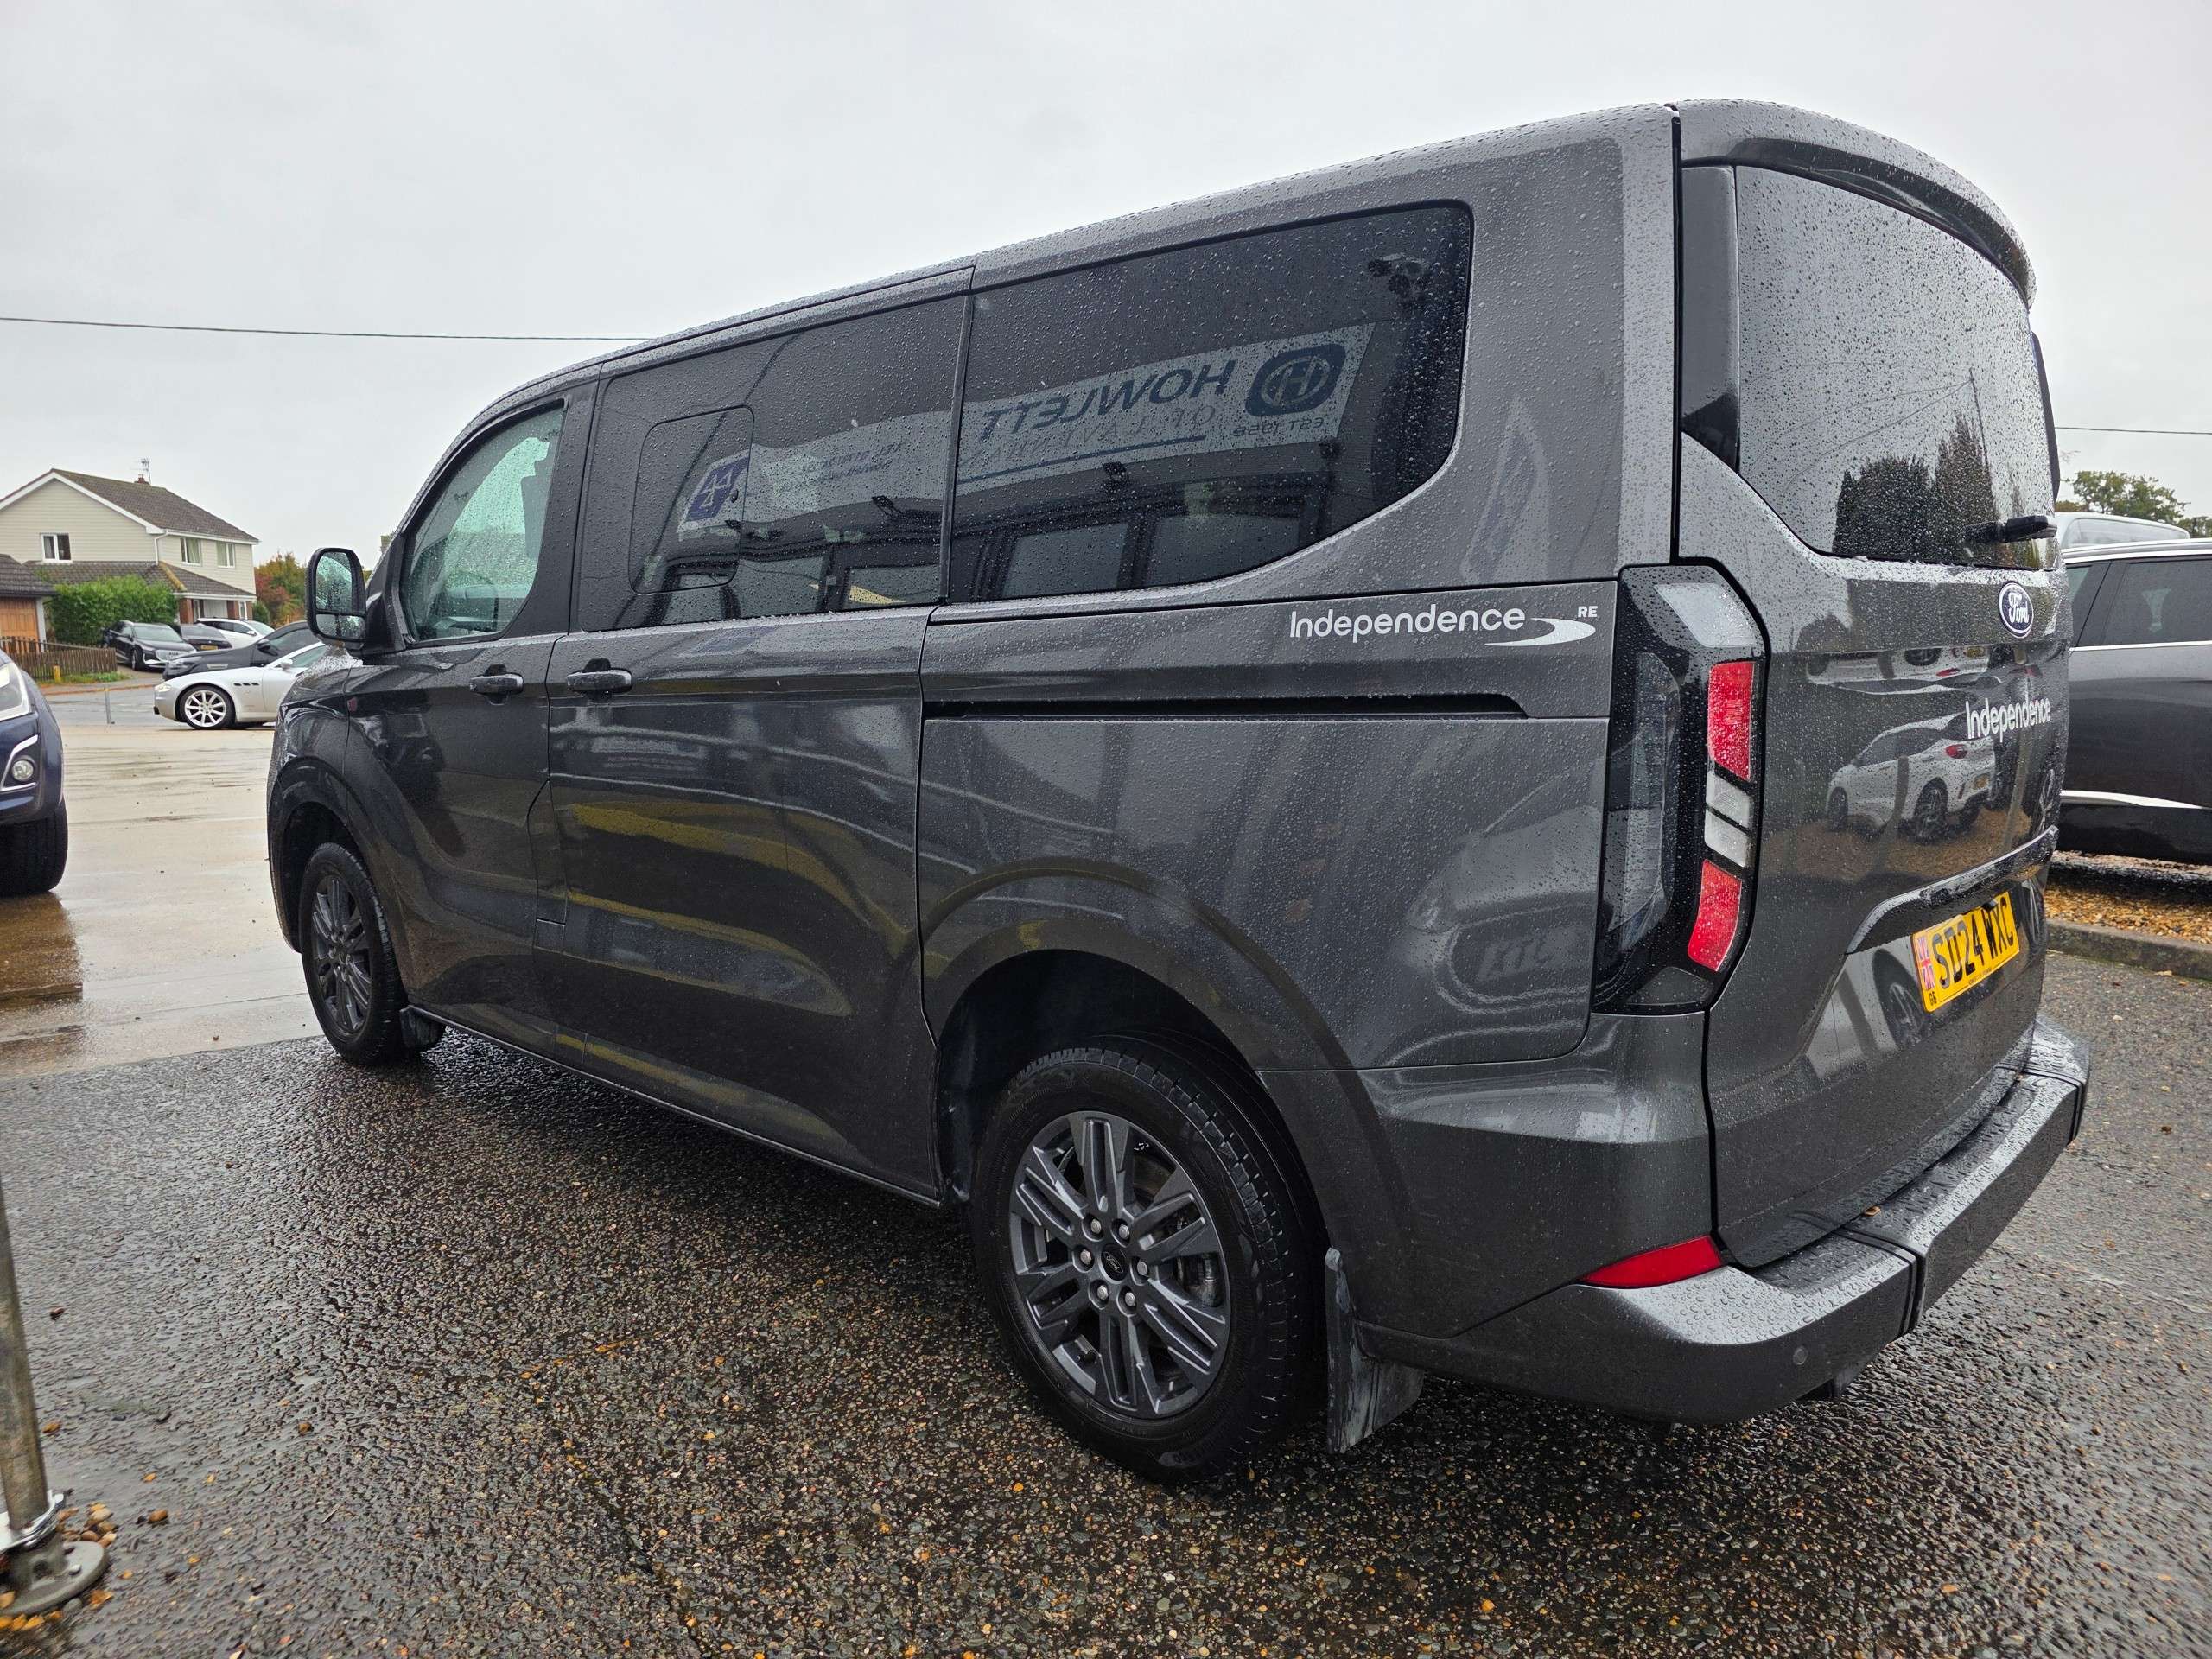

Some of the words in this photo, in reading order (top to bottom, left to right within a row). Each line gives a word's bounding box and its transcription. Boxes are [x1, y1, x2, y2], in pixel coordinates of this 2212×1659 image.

[1289, 604, 1526, 643] Independence
[1577, 606, 1599, 618] RE
[2007, 592, 2030, 624] Ford
[1965, 696, 2051, 743] Independence
[1932, 913, 1985, 989] SD24
